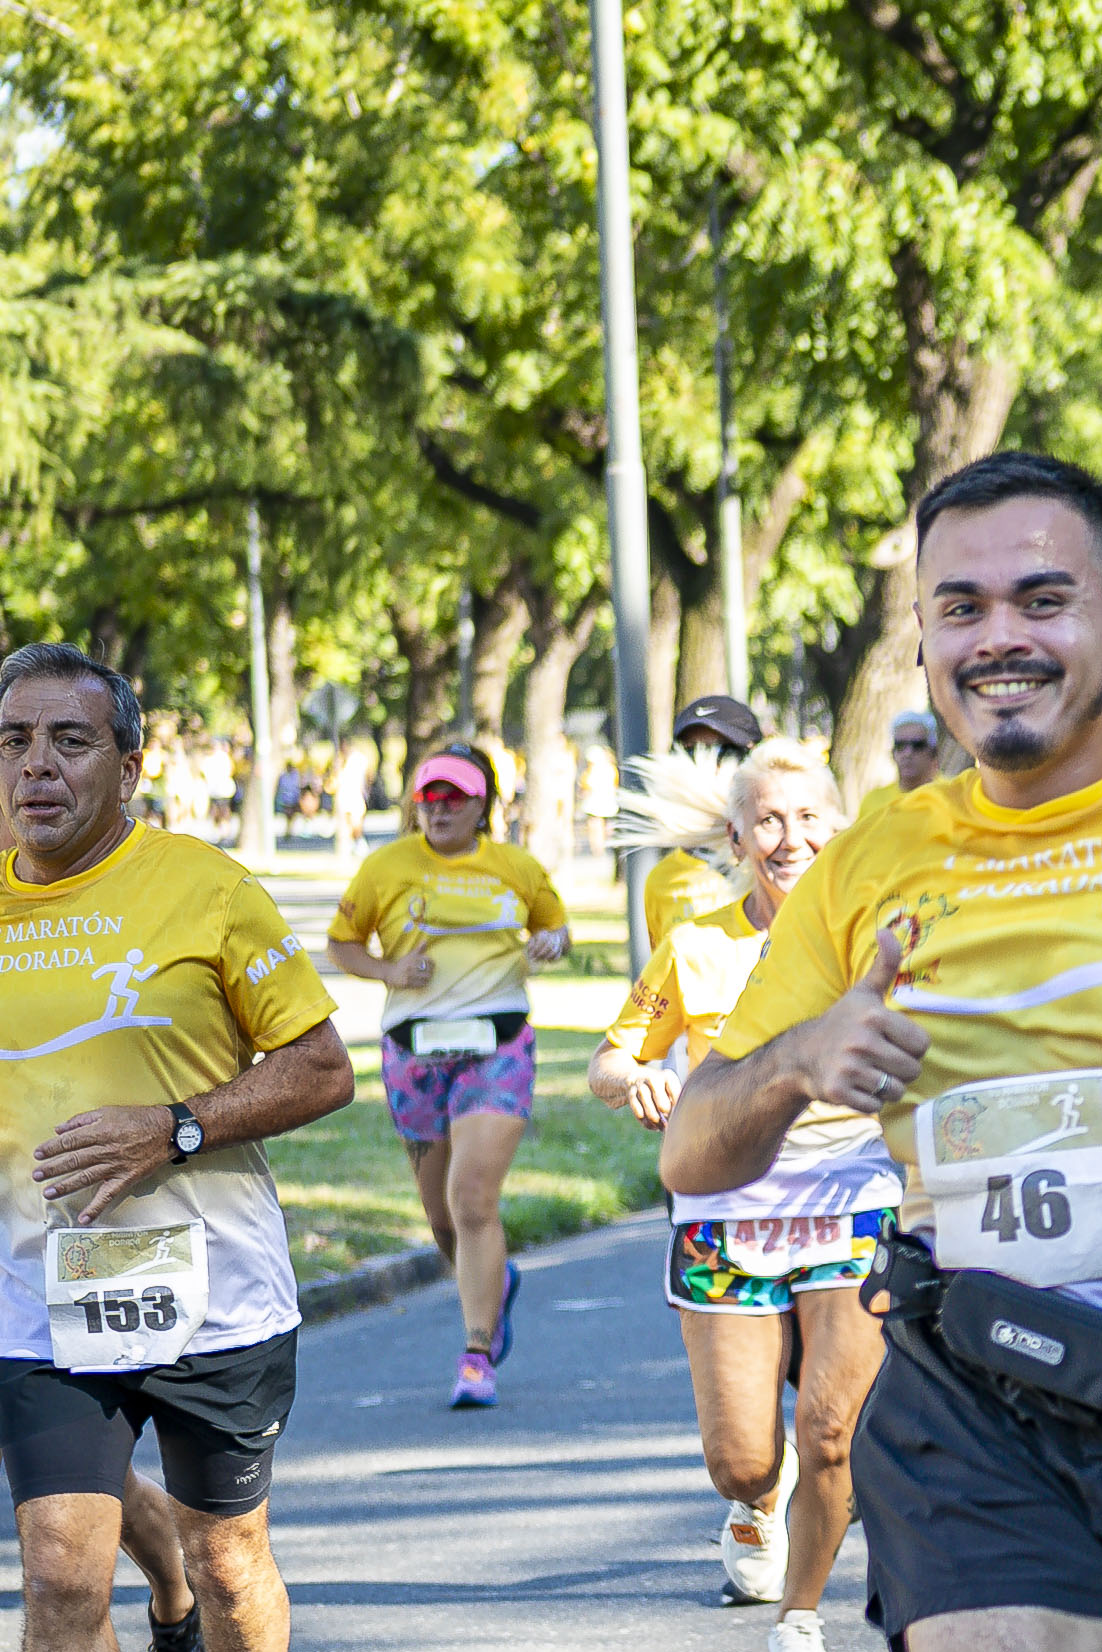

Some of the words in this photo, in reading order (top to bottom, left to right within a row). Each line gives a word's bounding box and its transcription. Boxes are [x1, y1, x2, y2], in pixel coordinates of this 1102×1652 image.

[5, 911, 124, 944] MARATÓN
[0, 946, 95, 973] DORADA
[981, 1168, 1072, 1243] 46
[74, 1285, 178, 1334] 153
